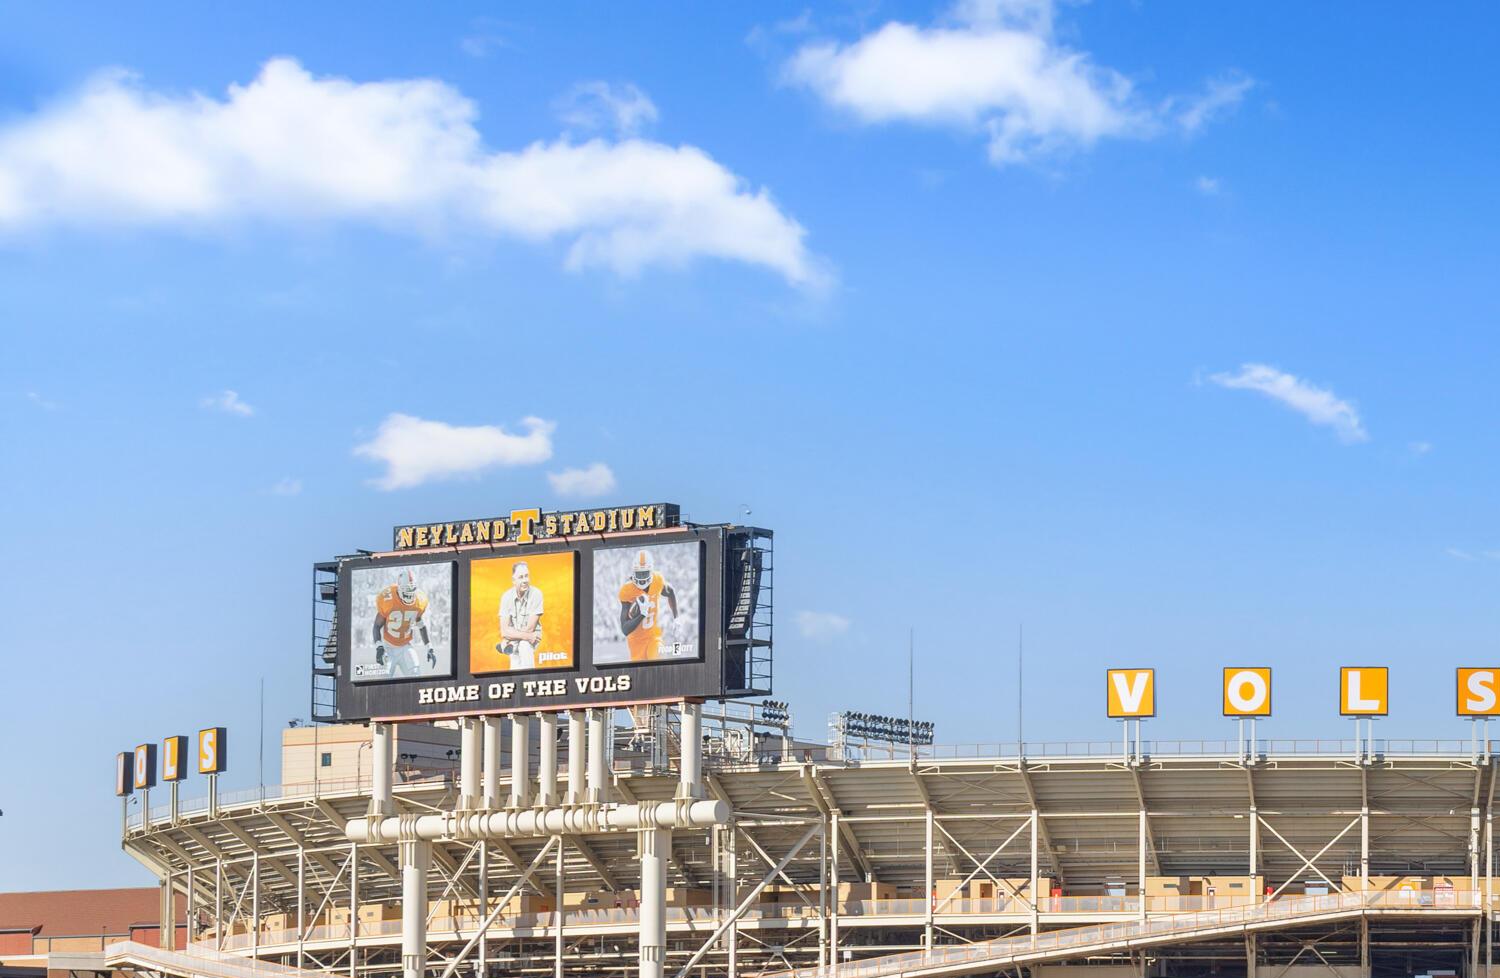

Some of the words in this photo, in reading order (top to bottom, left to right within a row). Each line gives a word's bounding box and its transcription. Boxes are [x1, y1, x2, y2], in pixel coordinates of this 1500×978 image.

[399, 520, 506, 547] NEYLAND
[510, 508, 541, 544] T
[545, 506, 655, 535] STADIUM
[418, 685, 480, 704] HOME
[488, 683, 515, 699] OF
[523, 679, 567, 697] THE
[575, 675, 631, 693] VOLS
